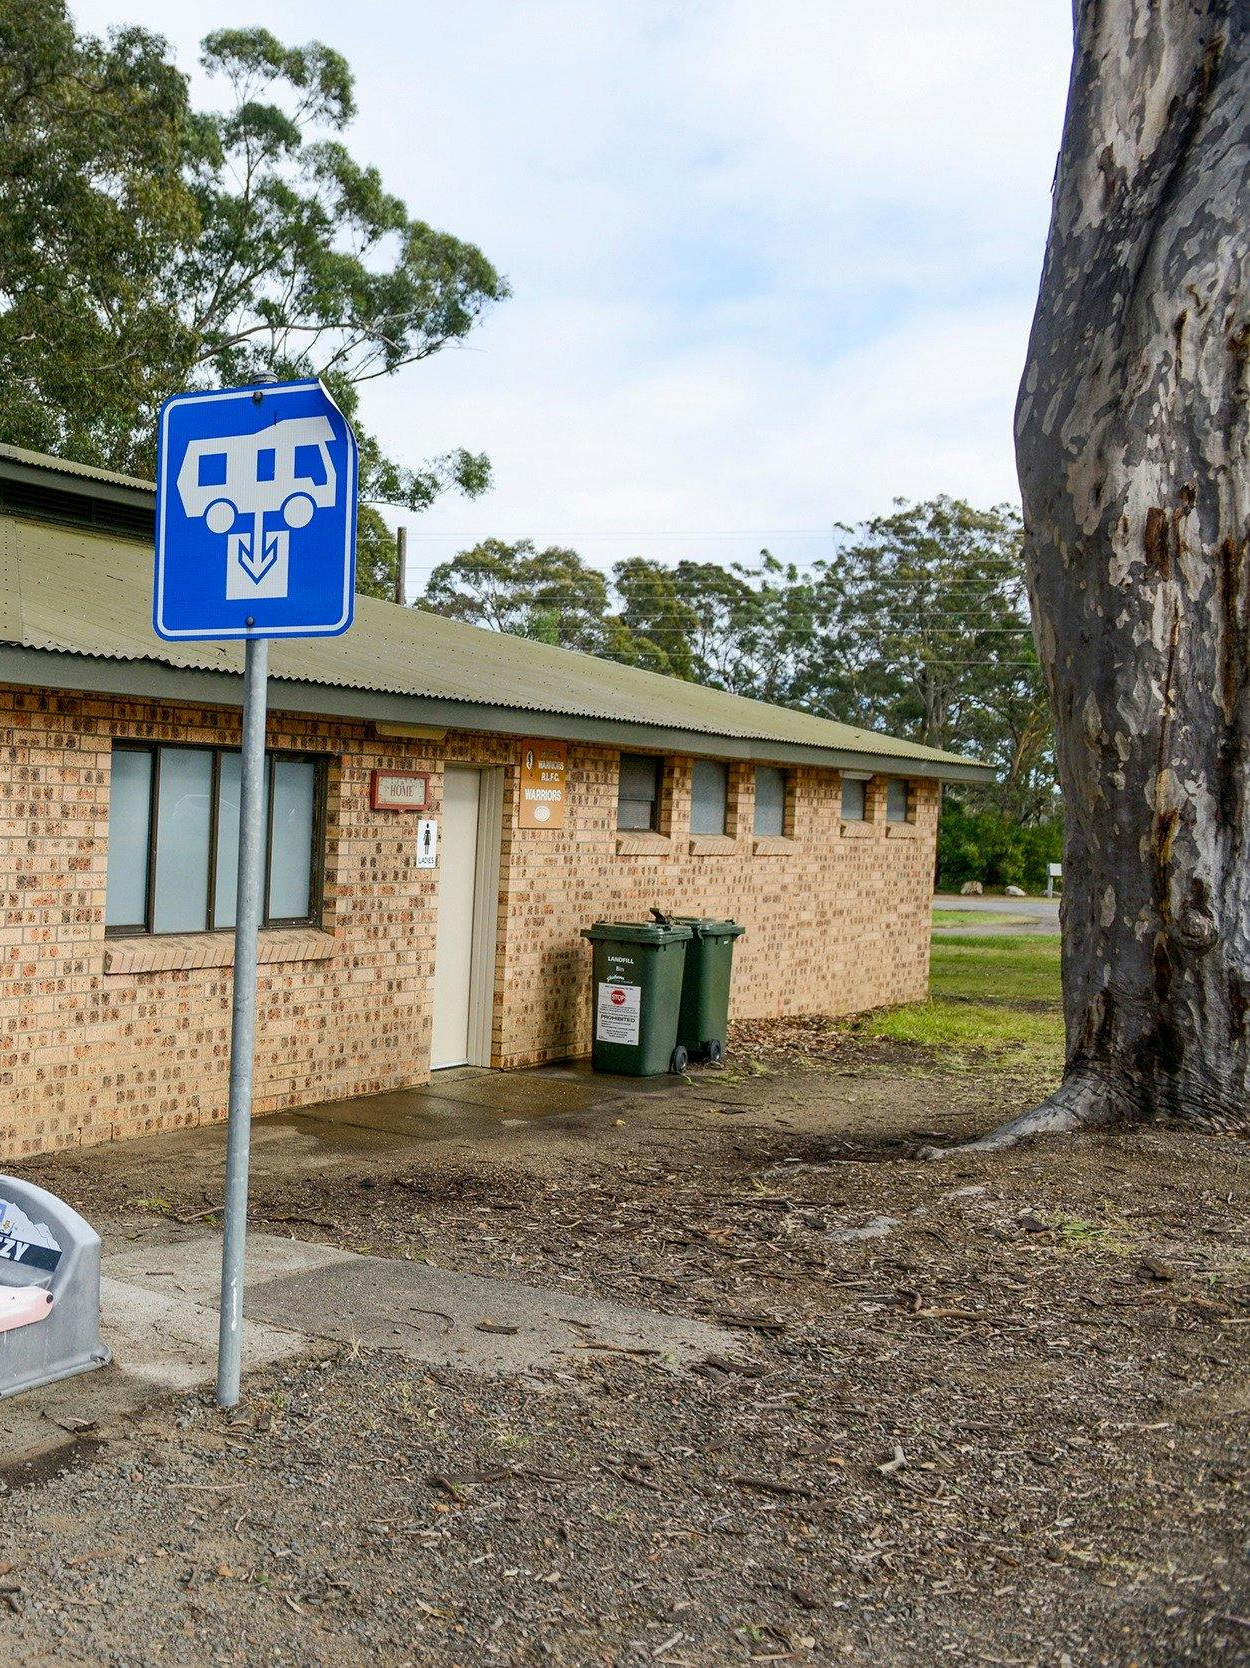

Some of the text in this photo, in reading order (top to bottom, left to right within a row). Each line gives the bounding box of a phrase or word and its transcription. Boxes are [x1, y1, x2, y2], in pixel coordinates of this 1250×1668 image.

[390, 784, 413, 797] HOME
[524, 788, 562, 802] WARRIORS
[607, 956, 634, 964] LANDFILL
[611, 993, 626, 1002] STOP
